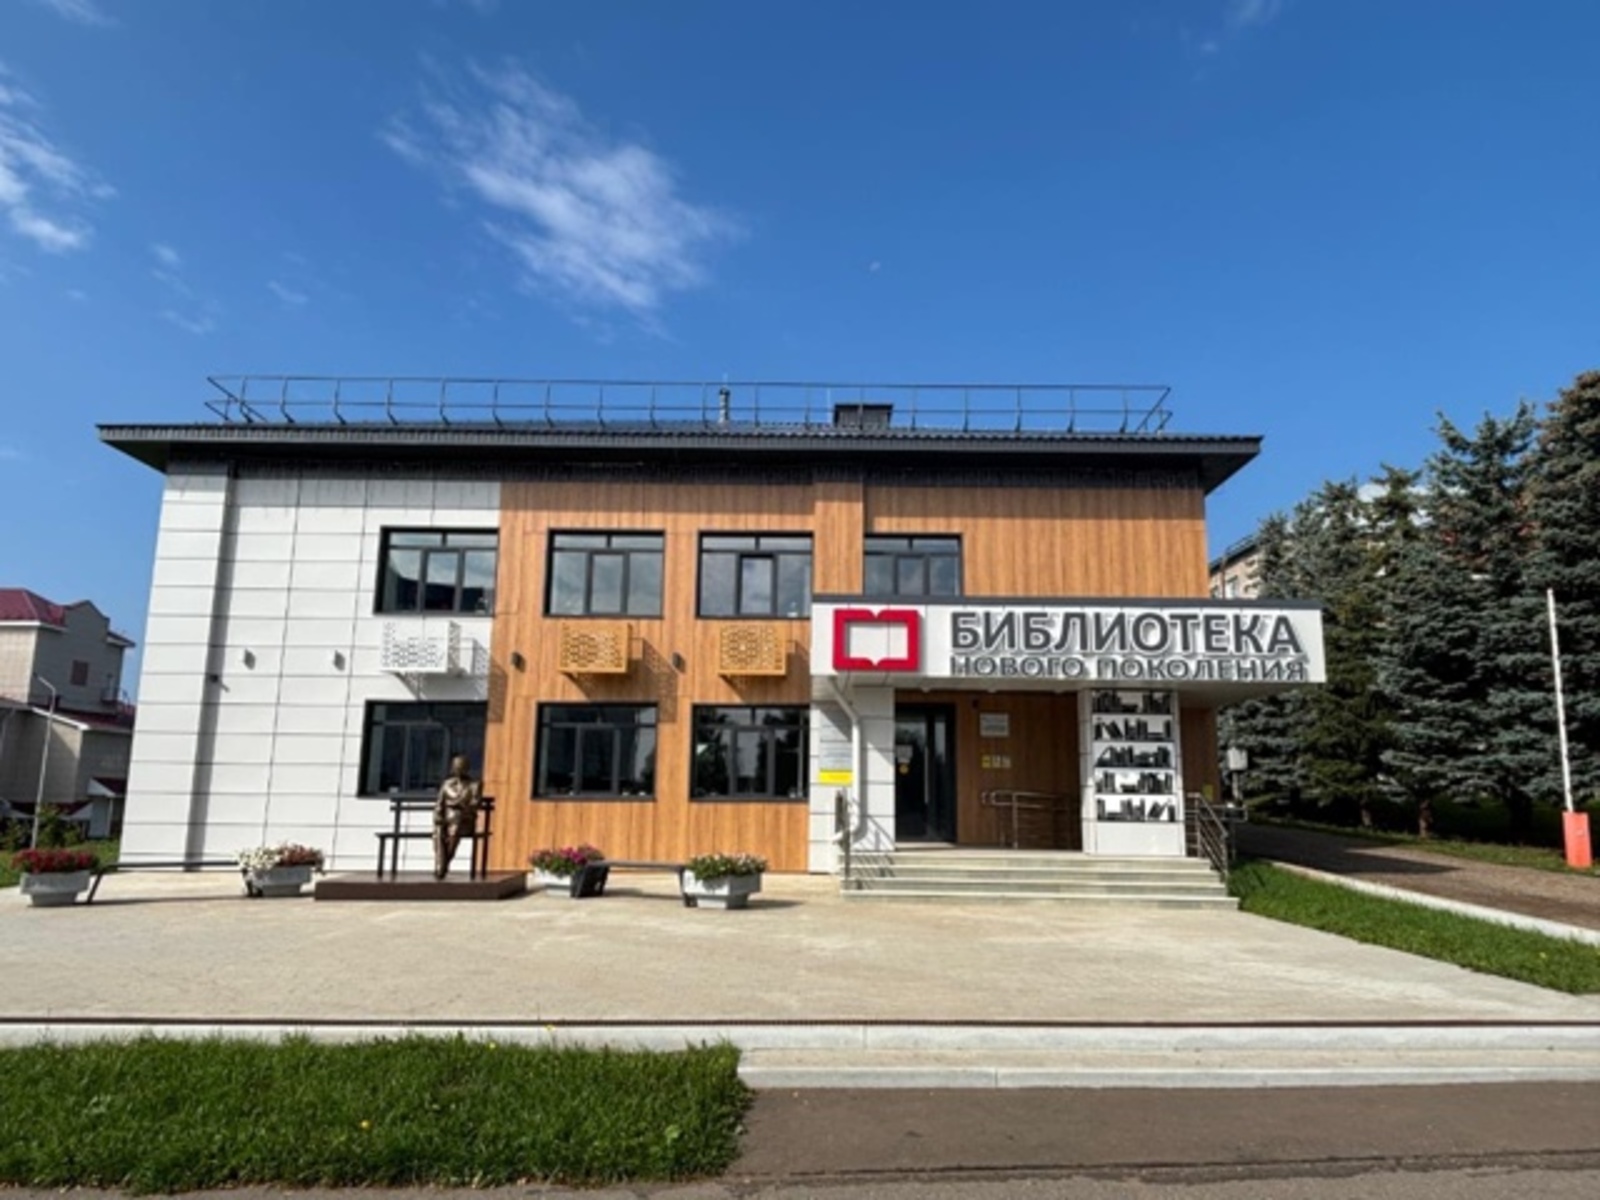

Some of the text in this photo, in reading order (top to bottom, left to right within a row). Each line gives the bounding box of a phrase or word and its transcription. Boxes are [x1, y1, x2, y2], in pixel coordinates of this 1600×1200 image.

[951, 611, 1302, 653] БИБЛИОТЕКА
[950, 655, 1308, 682] НОВОГО ПОКОЛЕНИЯ
